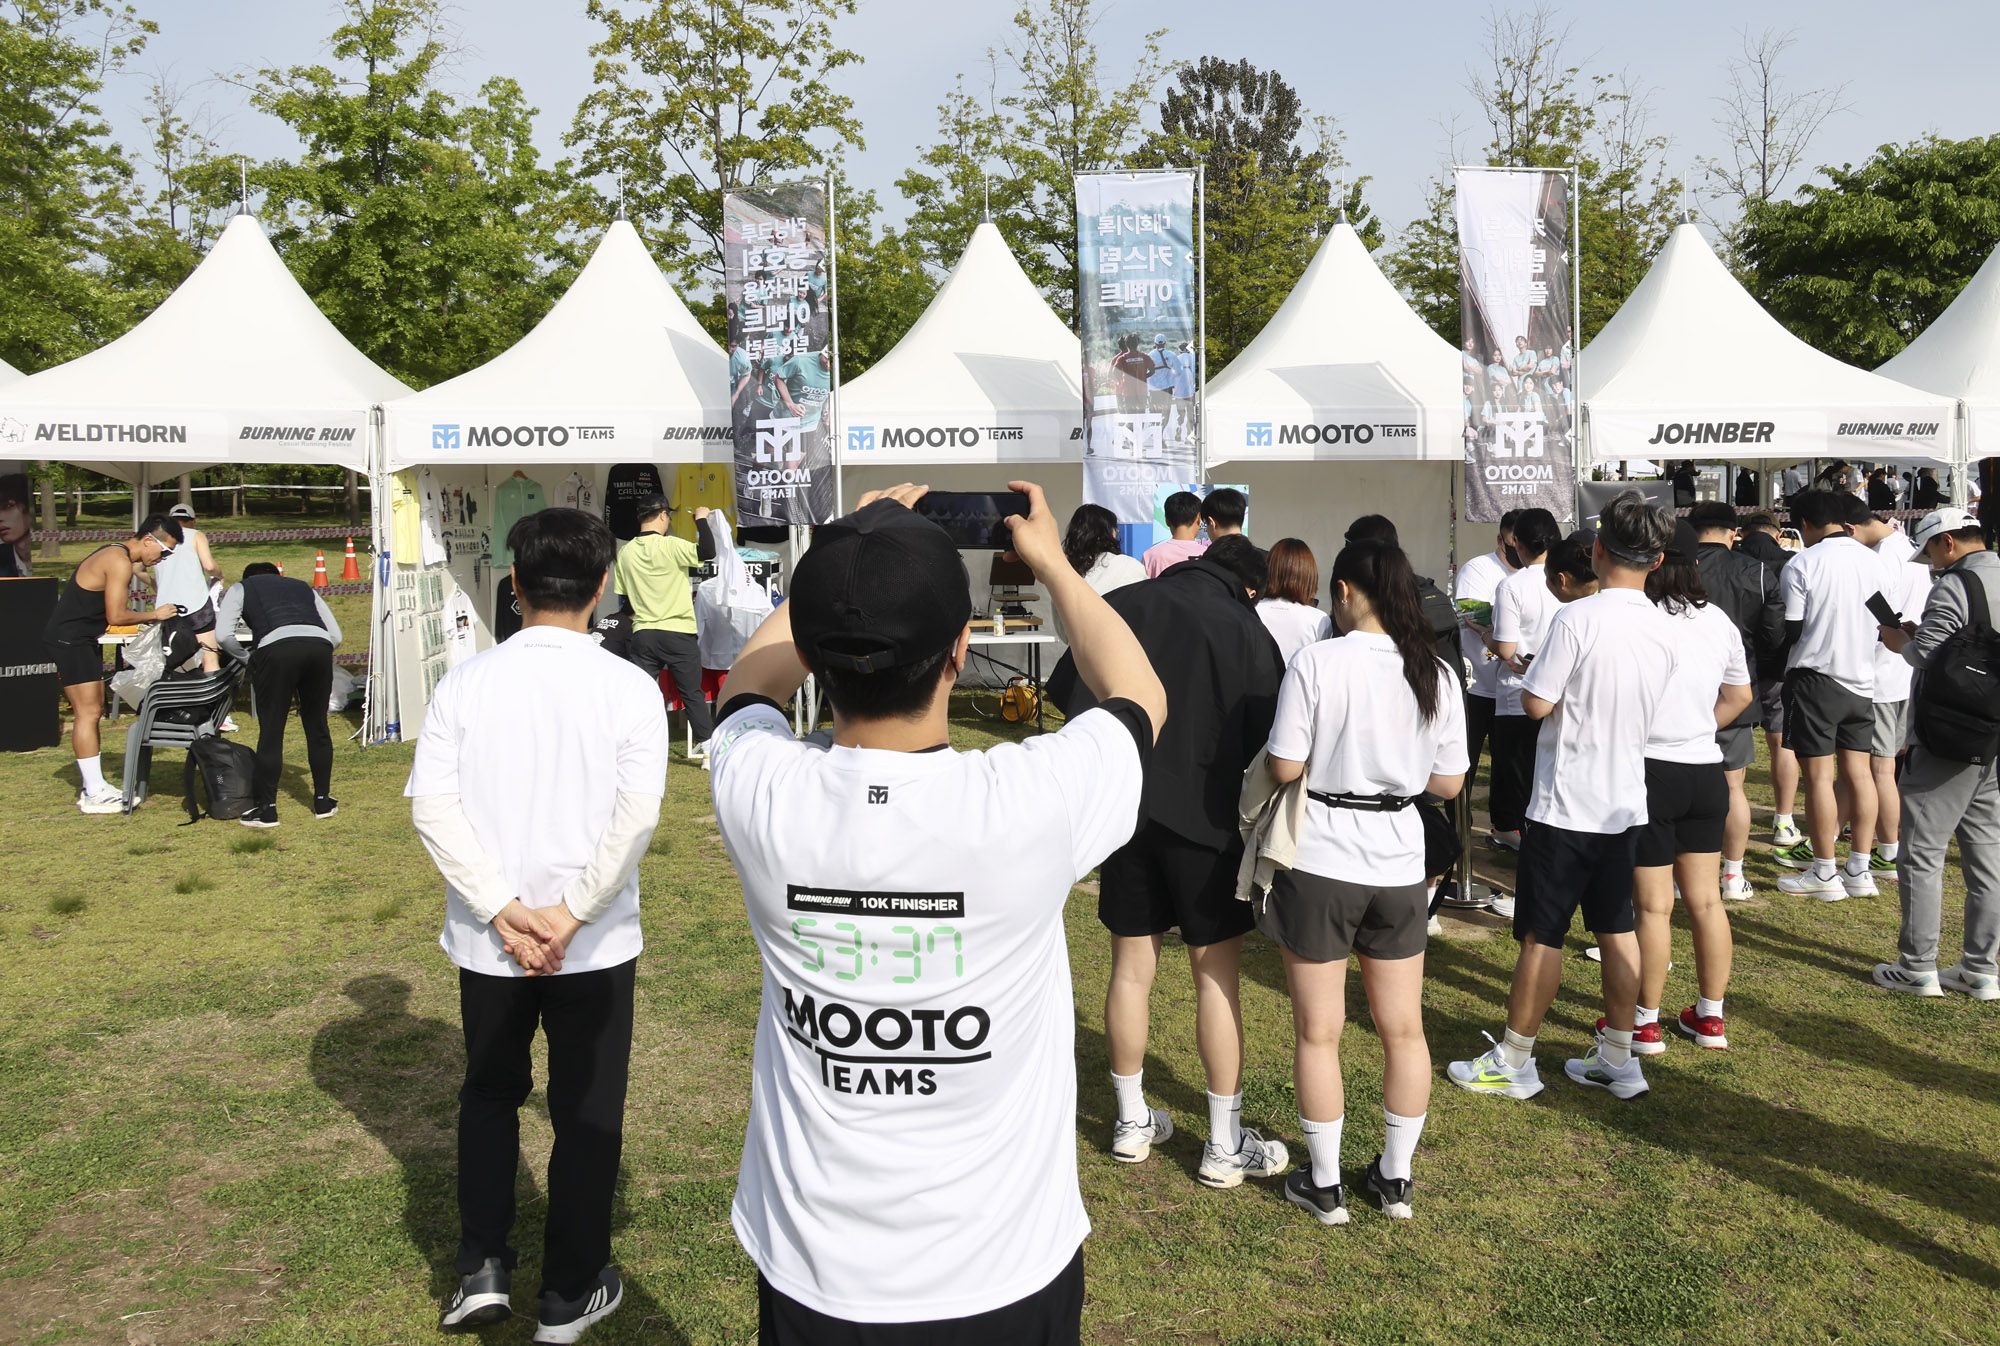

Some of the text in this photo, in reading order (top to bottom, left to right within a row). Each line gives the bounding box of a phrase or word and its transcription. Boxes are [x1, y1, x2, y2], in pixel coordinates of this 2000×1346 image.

[239, 426, 356, 441] BURNING RUN
[467, 426, 615, 447] MOOTO TEAMS
[881, 427, 1024, 448] MOOTO TEAMS
[1278, 424, 1416, 445] MOOTO TEAMS
[1648, 422, 1775, 444] JOHNBER
[1836, 423, 1940, 436] BURNING RUN
[794, 894, 958, 911] BURNING RUN 10K FINISHER
[792, 917, 963, 984] 53:37
[783, 986, 991, 1051] MOOTO
[815, 1047, 937, 1096] TEAMS
